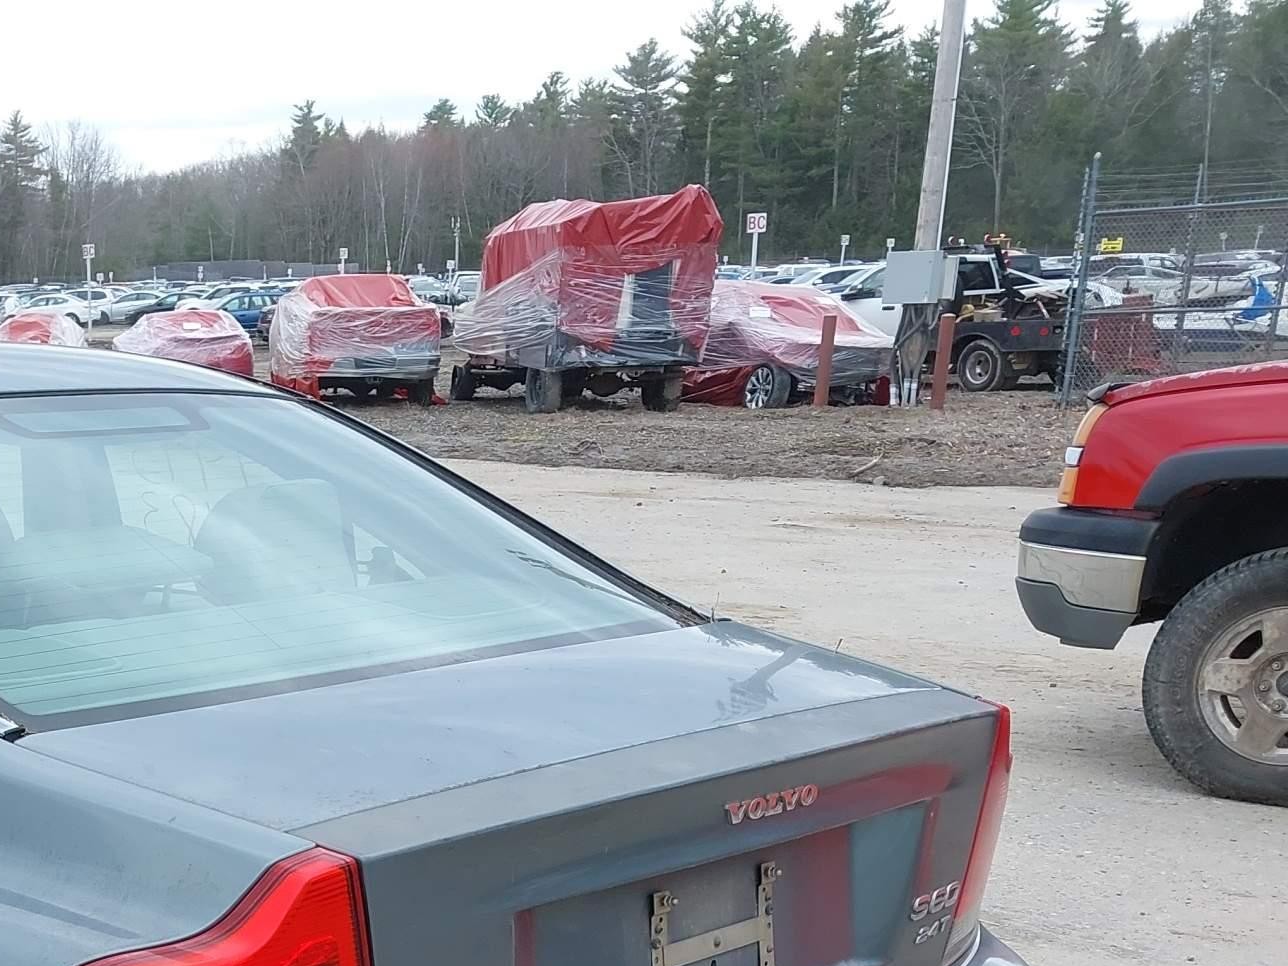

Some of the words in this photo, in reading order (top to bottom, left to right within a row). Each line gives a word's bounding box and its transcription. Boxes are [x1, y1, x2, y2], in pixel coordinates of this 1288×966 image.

[748, 215, 766, 231] BC
[724, 784, 818, 825] VOLVO
[910, 880, 960, 921] S60
